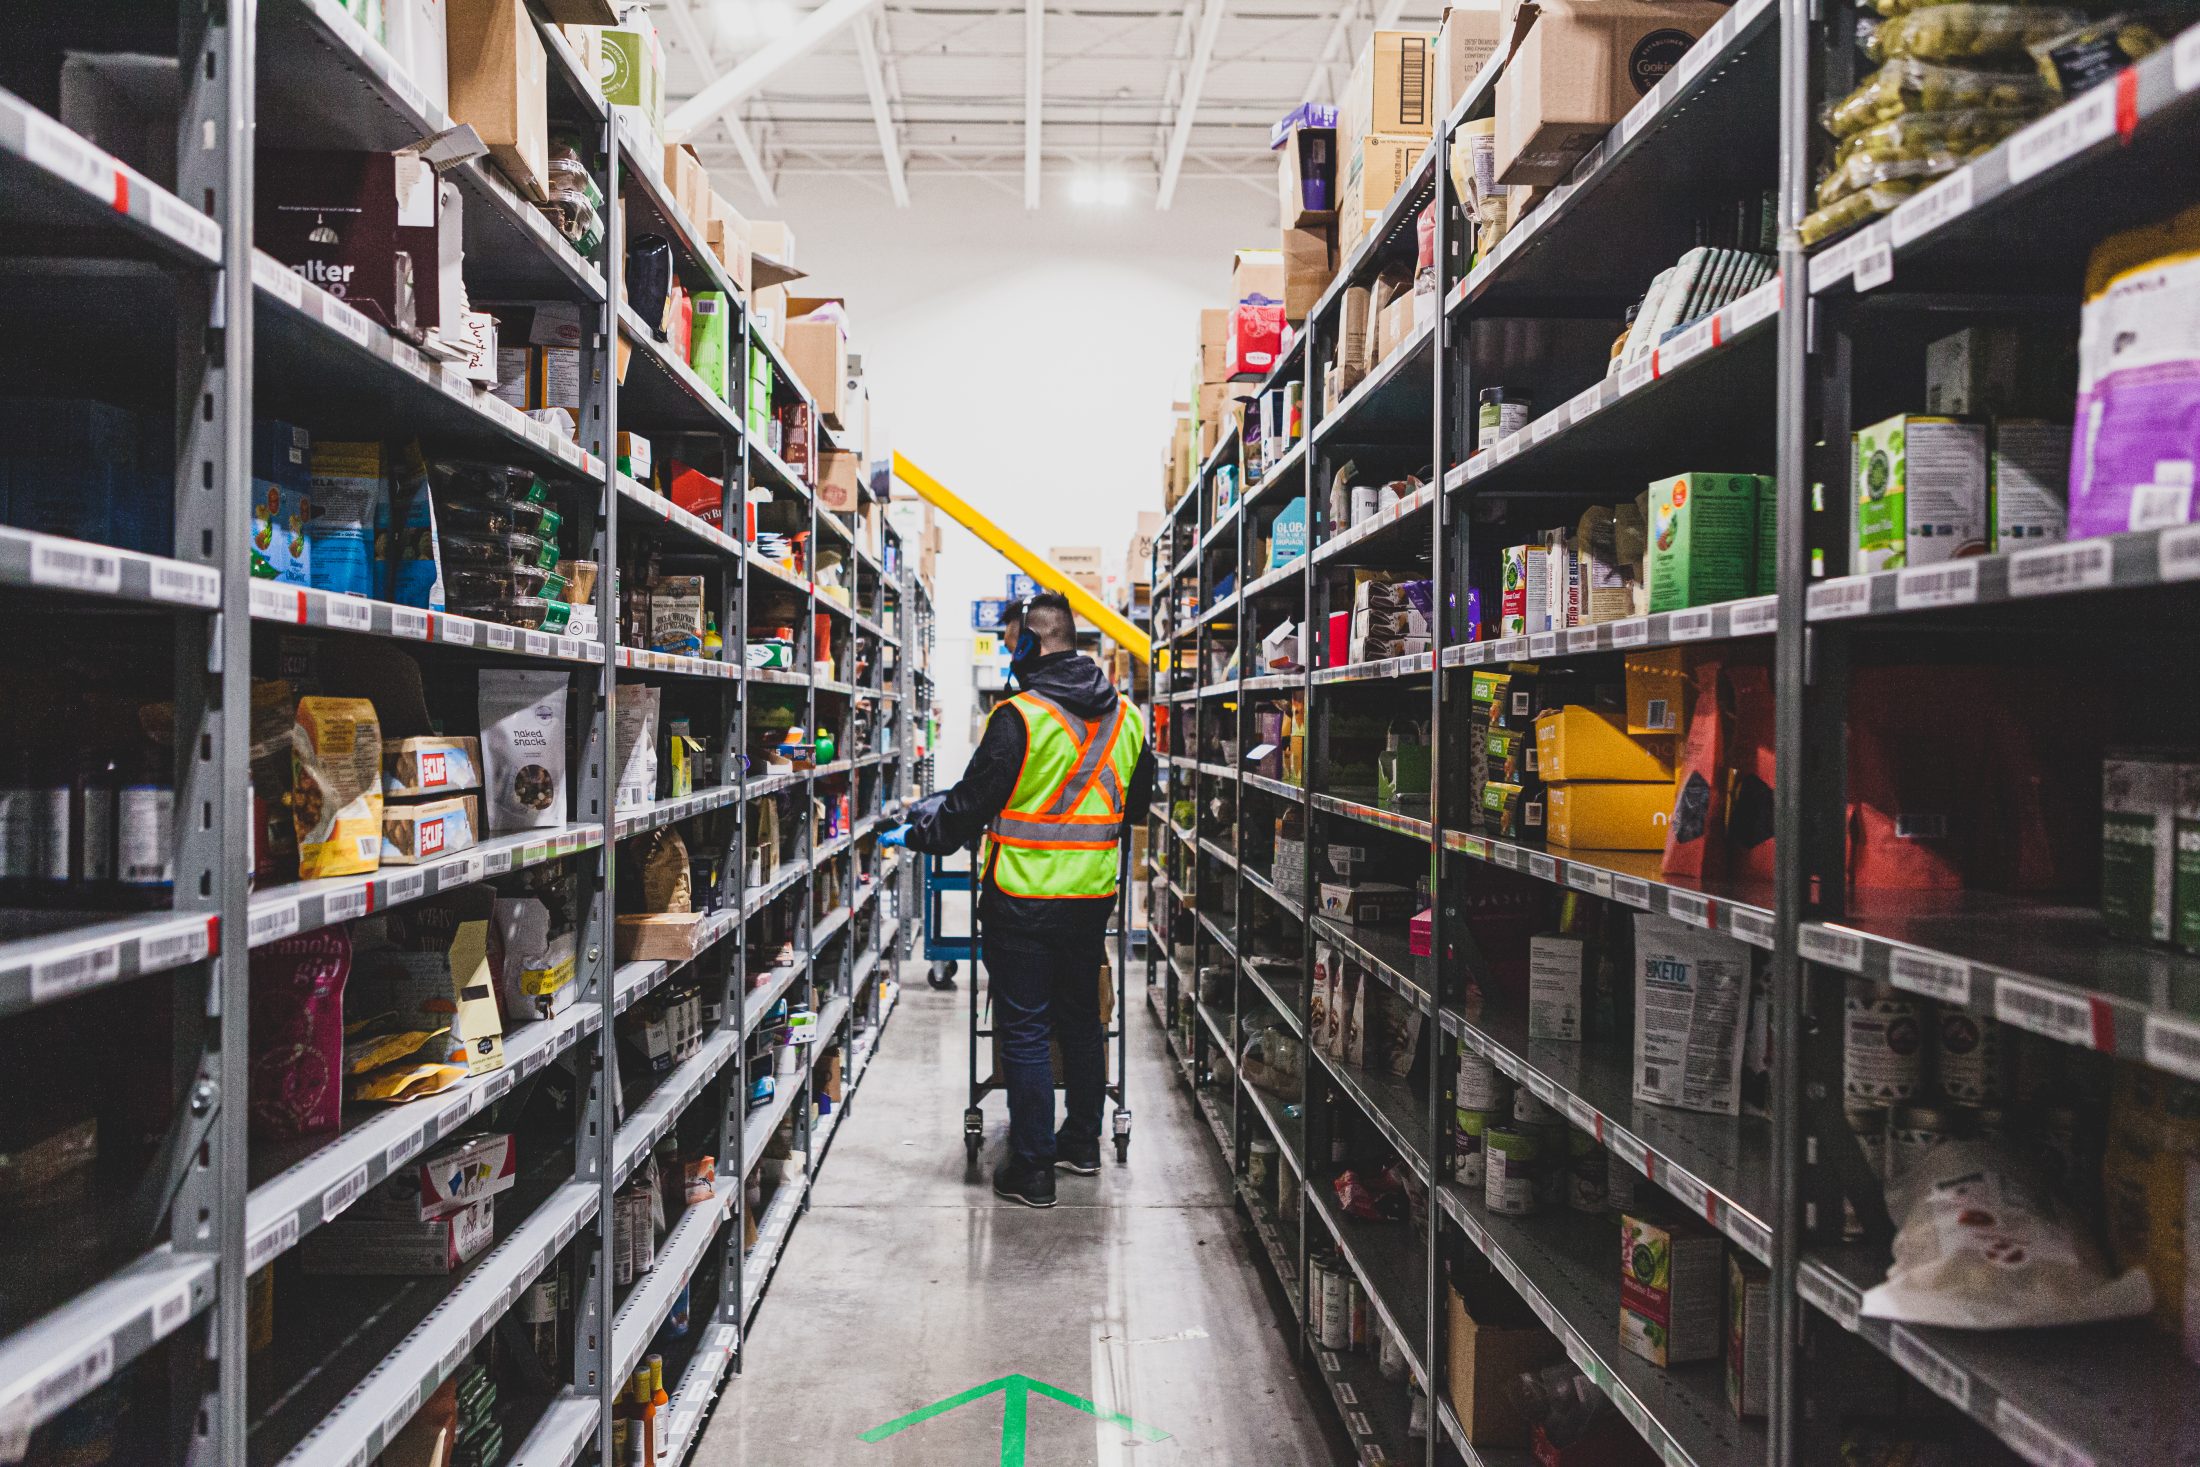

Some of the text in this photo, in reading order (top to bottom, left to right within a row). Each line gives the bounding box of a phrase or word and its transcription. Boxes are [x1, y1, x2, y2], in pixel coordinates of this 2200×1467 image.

[290, 260, 354, 282] alter
[514, 730, 543, 738] naked
[514, 737, 546, 746] snacks
[266, 934, 343, 956] ranola
